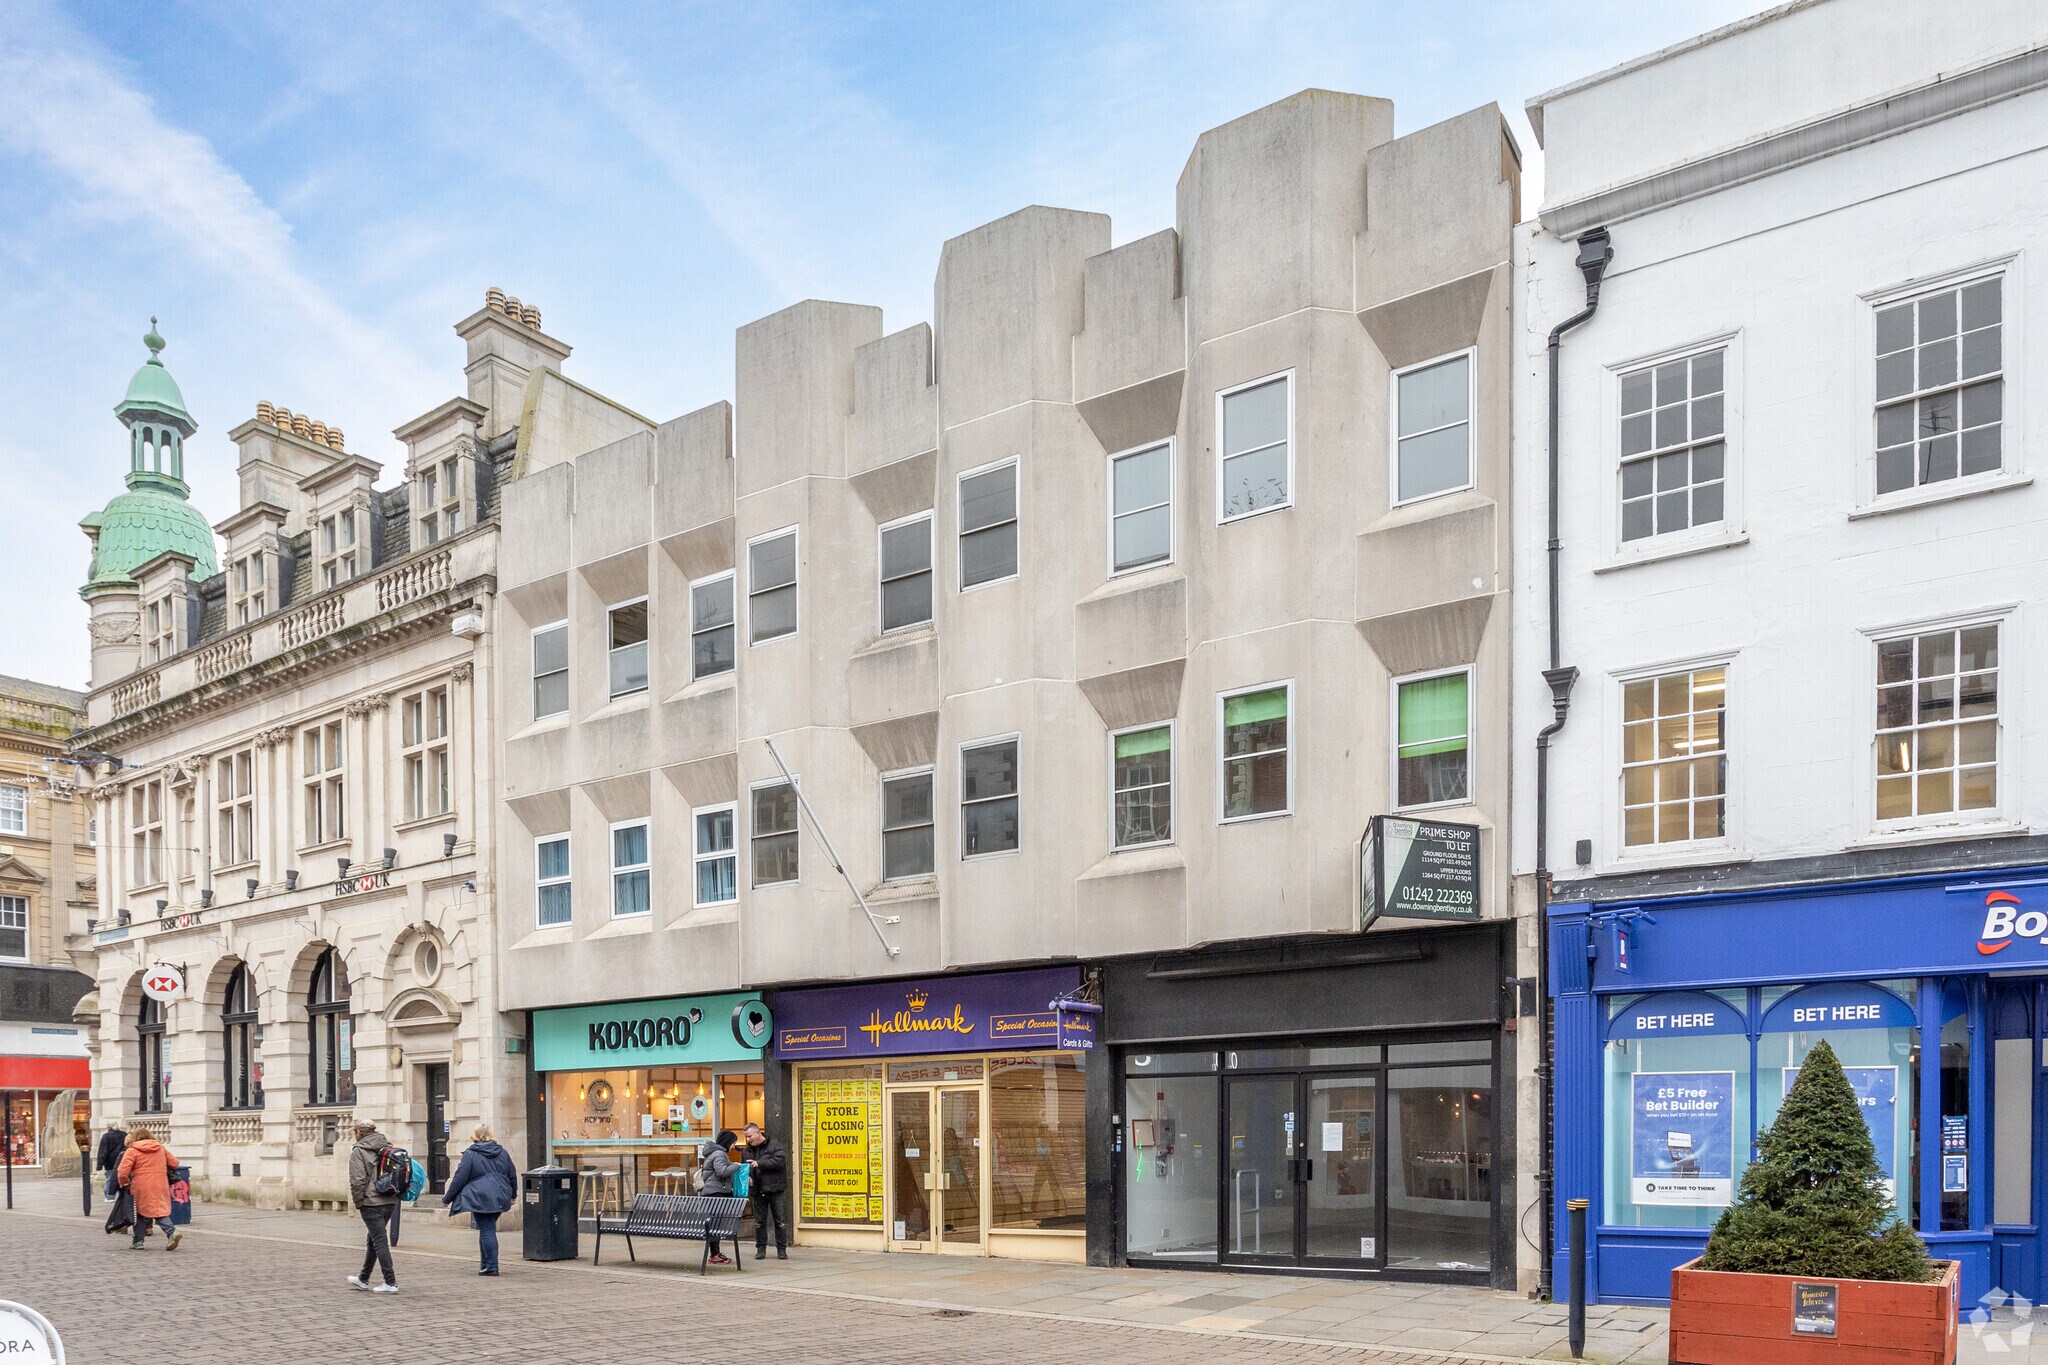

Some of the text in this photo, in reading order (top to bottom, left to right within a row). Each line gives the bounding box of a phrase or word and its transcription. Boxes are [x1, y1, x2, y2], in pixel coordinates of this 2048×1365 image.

[1420, 827, 1471, 840] PRIME SHOP
[1446, 841, 1471, 851] TO LET
[1422, 850, 1443, 858] GROUND
[1455, 868, 1471, 876] FLOORS
[335, 872, 391, 897] HSBC UK
[1460, 875, 1468, 883] SQ
[1402, 885, 1473, 905] 01242 222369
[1395, 902, 1473, 914] www.downingbentley.co.uk
[160, 911, 202, 932] HSBC UK
[1982, 906, 2048, 946] Bo
[1793, 1004, 1881, 1023] BET HERE
[859, 1003, 976, 1049] Hallmark
[996, 1020, 1026, 1032] Special
[1063, 1018, 1093, 1034] Hallmark
[1636, 1013, 1715, 1030] BET HERE
[588, 1015, 692, 1051] KOKORO
[785, 1033, 842, 1046] Special Occasions
[1063, 1038, 1078, 1048] Cards
[1082, 1039, 1093, 1049] Gifts
[1657, 1088, 1708, 1099] £5 Free
[1646, 1100, 1720, 1111] Bet Builder
[826, 1107, 859, 1117] STORE
[821, 1121, 864, 1131] CLOSING
[827, 1136, 859, 1145] DOWN
